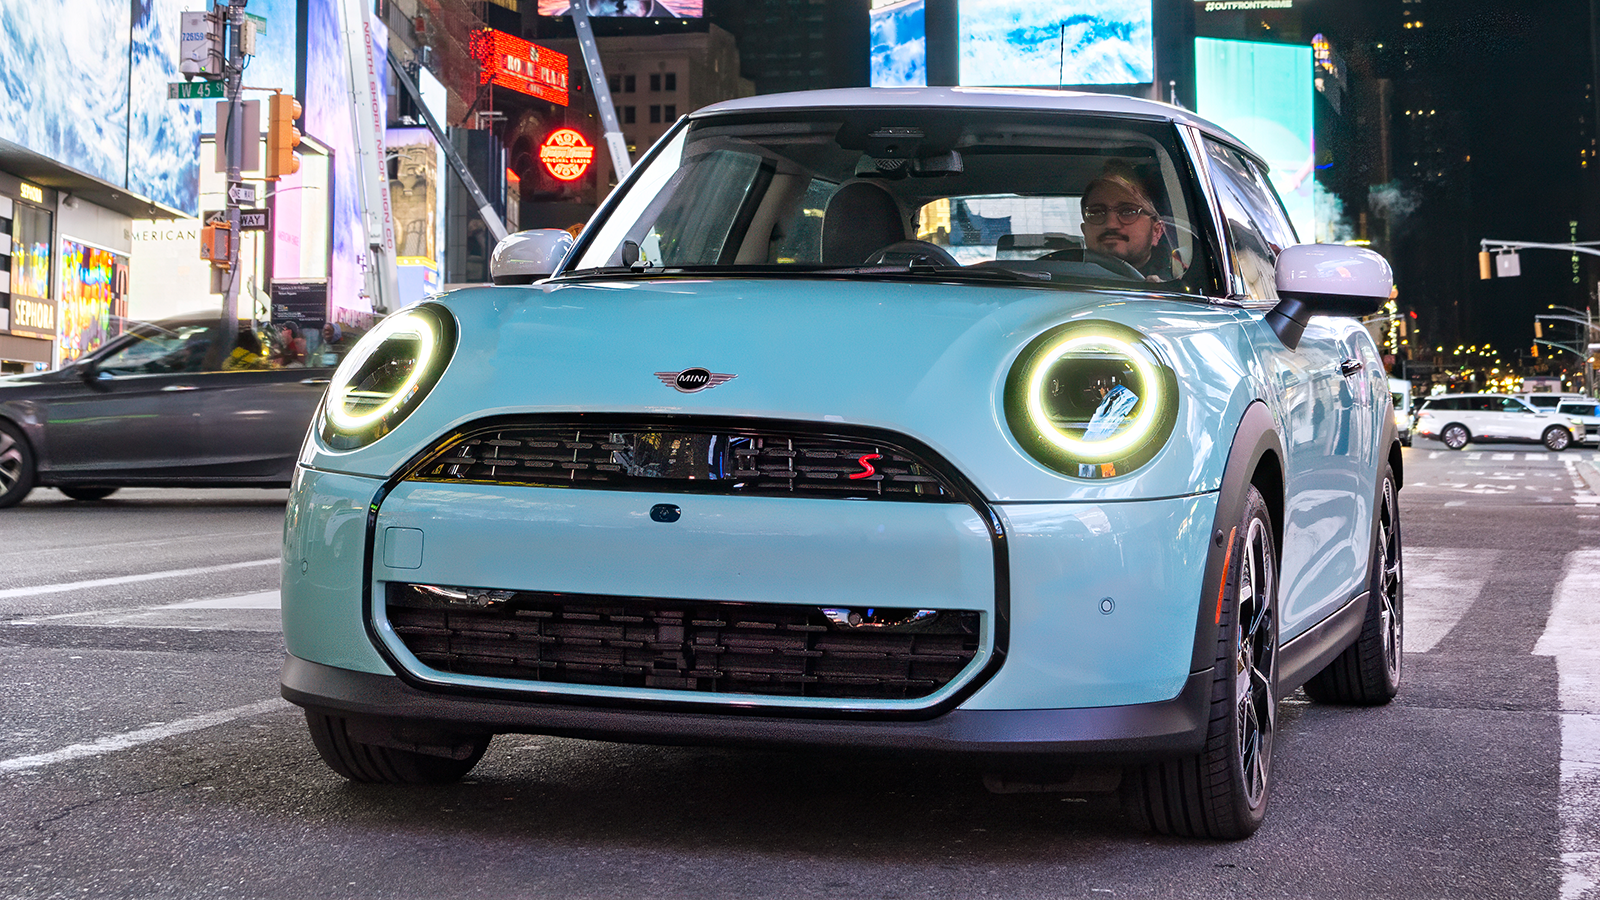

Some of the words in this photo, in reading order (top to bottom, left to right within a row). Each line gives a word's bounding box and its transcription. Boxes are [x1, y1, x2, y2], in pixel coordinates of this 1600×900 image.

[1205, 0, 1292, 12] #OUTFRONTPRIME
[182, 32, 204, 41] 726159
[181, 84, 192, 98] W
[197, 83, 211, 97] 45
[363, 21, 374, 75] NORTH
[369, 81, 381, 133] SHORE
[376, 139, 386, 183] NEON
[381, 188, 391, 224] SIGN
[554, 133, 580, 146] HOT
[553, 164, 580, 177] NOW
[231, 188, 241, 199] ONE
[240, 215, 260, 225] WAY
[14, 299, 55, 330] SEPHORA
[678, 375, 707, 383] MINI
[849, 453, 880, 480] S
